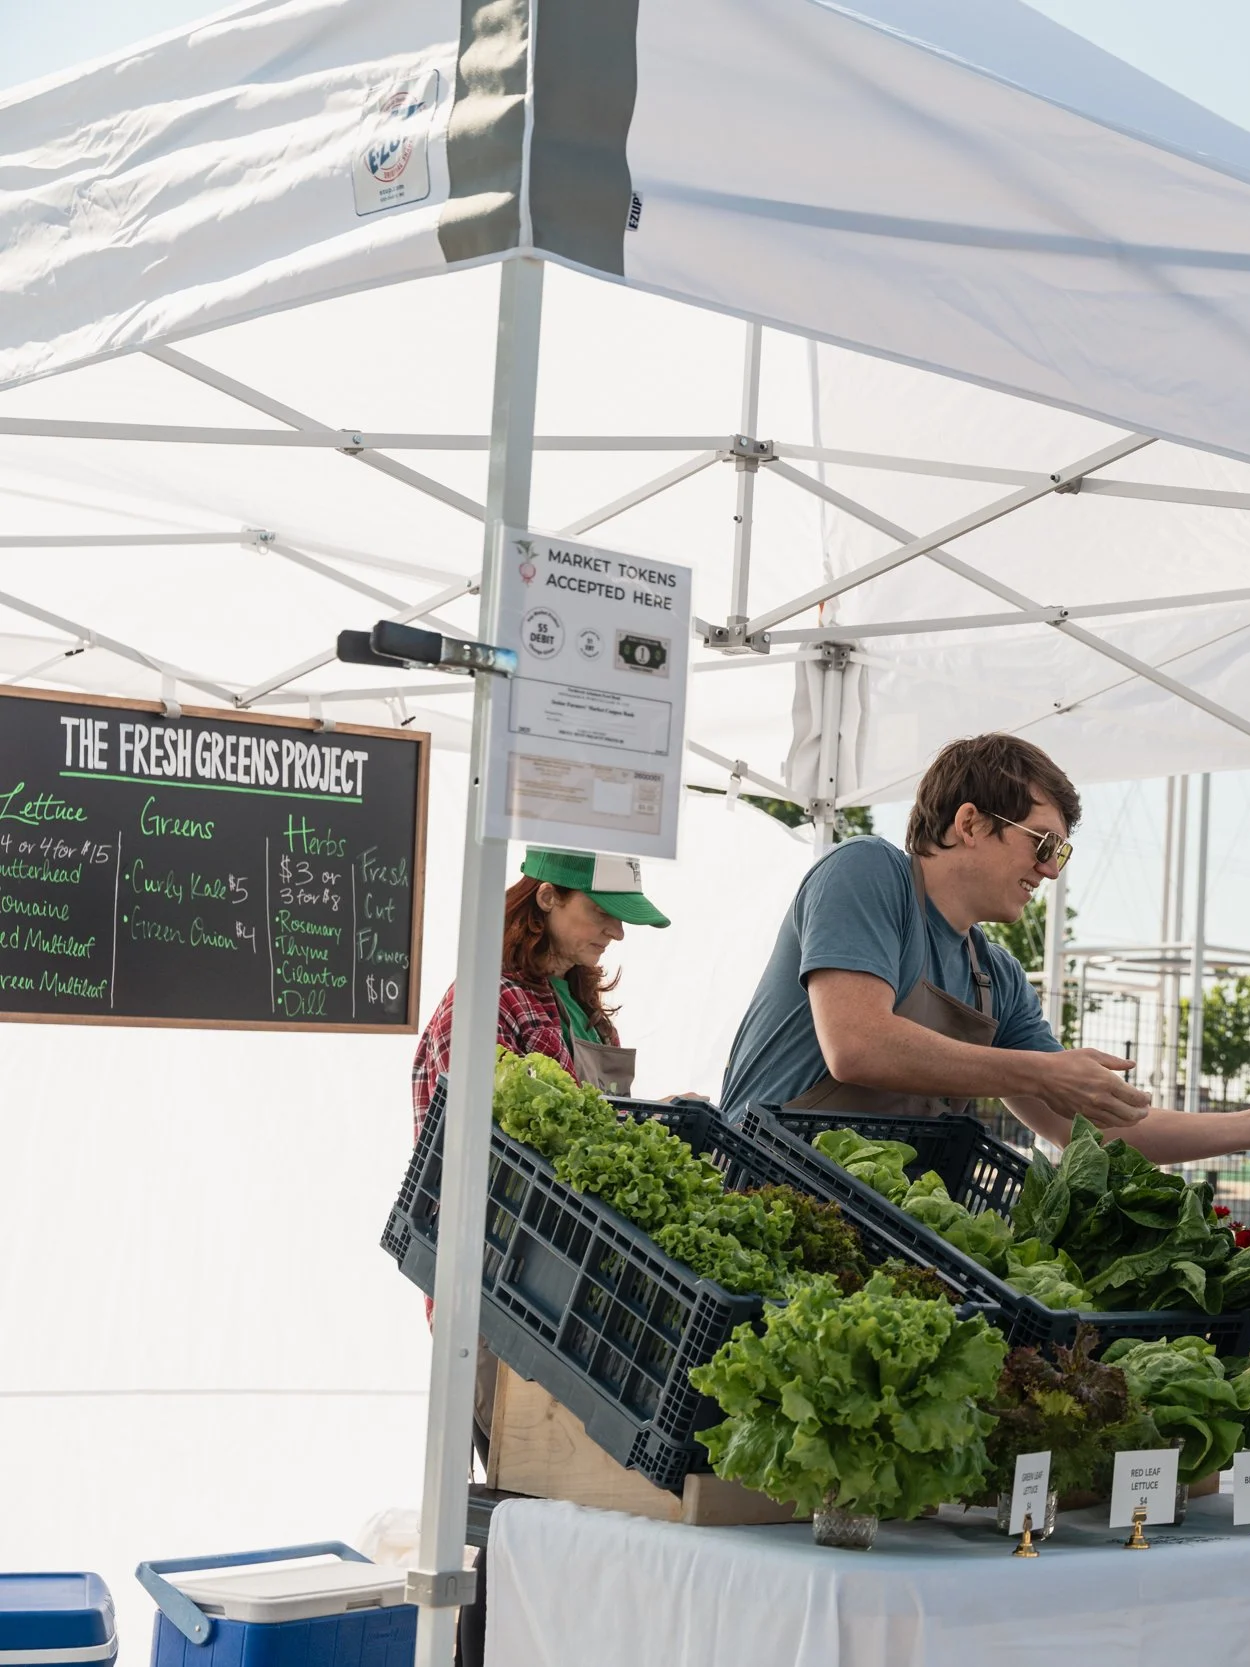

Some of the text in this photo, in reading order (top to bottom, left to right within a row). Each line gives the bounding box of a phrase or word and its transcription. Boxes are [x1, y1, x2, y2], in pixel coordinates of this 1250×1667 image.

[548, 548, 677, 588] MARKET TOKENS
[545, 573, 673, 611] ACCEPTED HERE
[530, 632, 555, 645] DEBIT
[538, 623, 548, 633] $5
[60, 716, 368, 796] THE FRESH GREENS PROJECT
[0, 782, 87, 825] Lettuce
[141, 796, 215, 839] Greens
[19, 842, 36, 854] or
[40, 837, 53, 857] 4
[53, 840, 78, 859] for
[81, 840, 112, 864] $15
[283, 814, 346, 857] Herbs
[0, 858, 82, 884] utterhead
[132, 858, 249, 905] Curly Kale $5
[279, 854, 342, 886] $3 or
[356, 846, 409, 887] Fresh
[0, 895, 69, 921] omaine
[280, 888, 341, 912] 3 for $8
[365, 893, 396, 923] Cut
[131, 905, 257, 954] Green Onion $4
[279, 910, 342, 945] Rosemary
[24, 928, 96, 959] Multileaf
[277, 935, 329, 965] Thyme
[357, 928, 410, 969] Flowers
[39, 970, 107, 999] Multileaf
[282, 961, 348, 988] Cilantro
[366, 974, 400, 1004] $10
[282, 989, 328, 1017] Dill
[1130, 1467, 1161, 1477] RED LEAF
[1131, 1481, 1159, 1490] LETTUCE
[1140, 1497, 1148, 1505] $4
